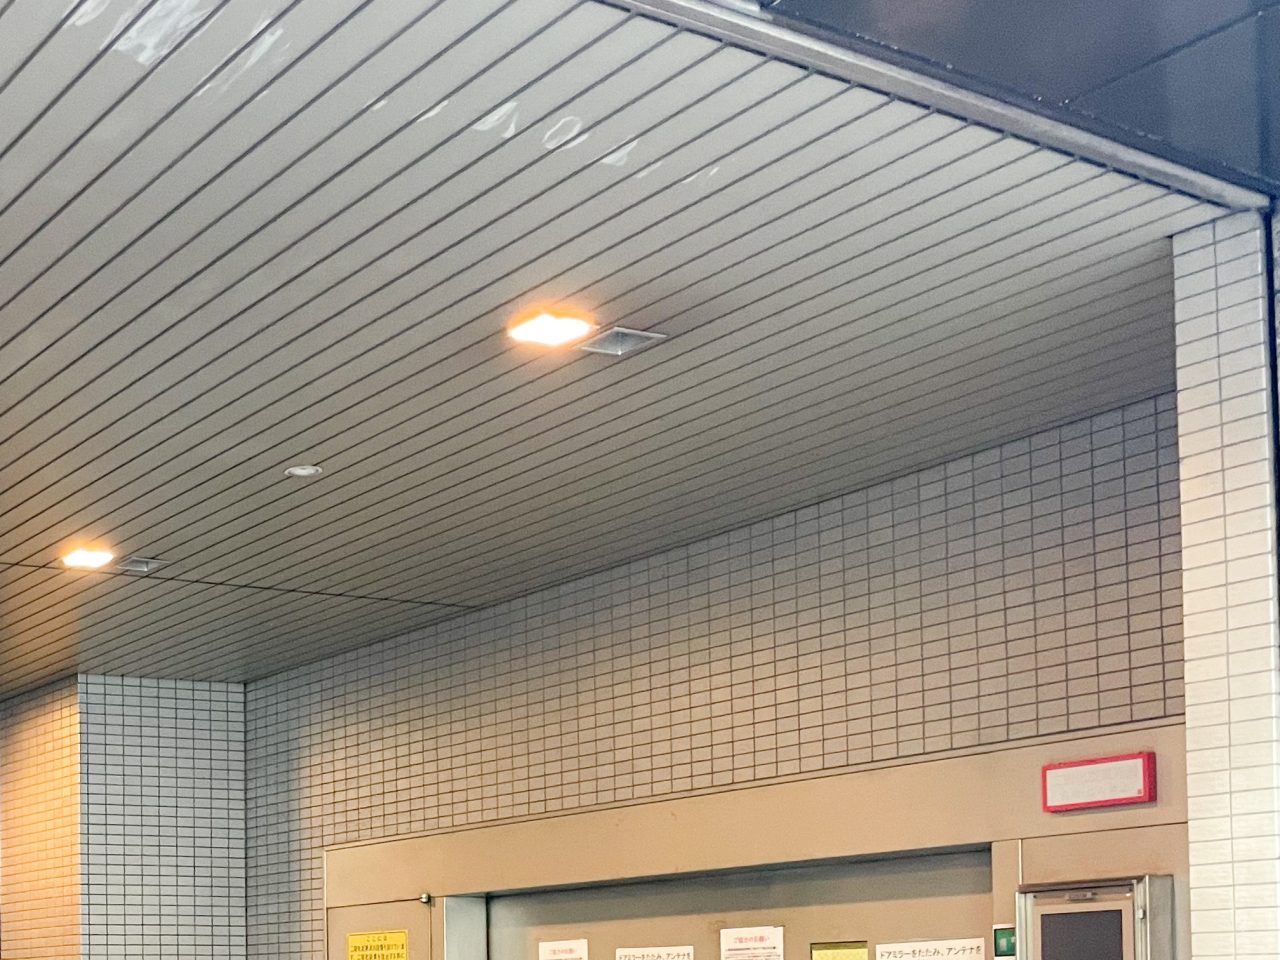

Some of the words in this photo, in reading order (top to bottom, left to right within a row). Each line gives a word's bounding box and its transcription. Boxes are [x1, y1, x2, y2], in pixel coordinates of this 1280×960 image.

[880, 946, 982, 959] ドアミラーをたたみ、アンテナを
